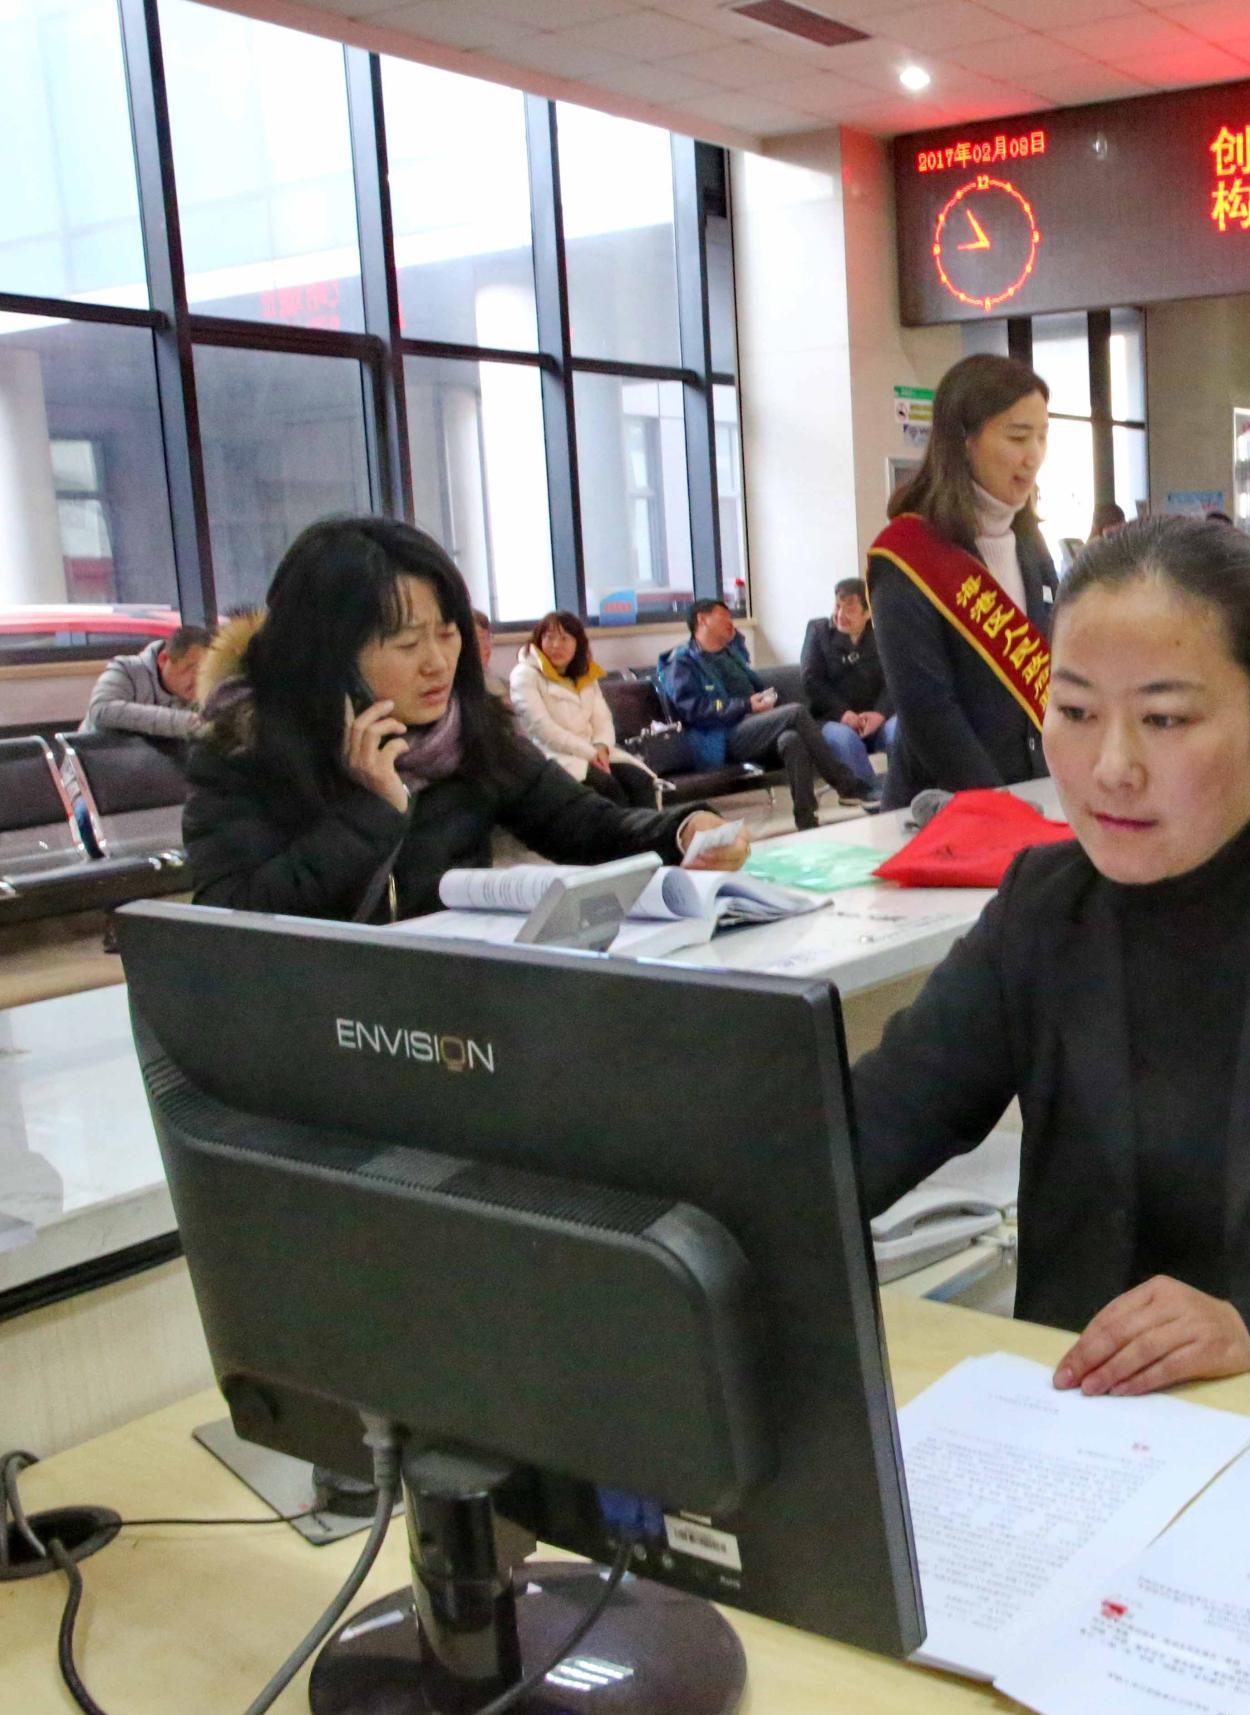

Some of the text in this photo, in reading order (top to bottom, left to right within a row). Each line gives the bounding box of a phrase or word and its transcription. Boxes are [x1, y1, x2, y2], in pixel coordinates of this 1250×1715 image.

[918, 131, 1045, 172] 2017年02月08日
[336, 1018, 495, 1074] ENVISION
